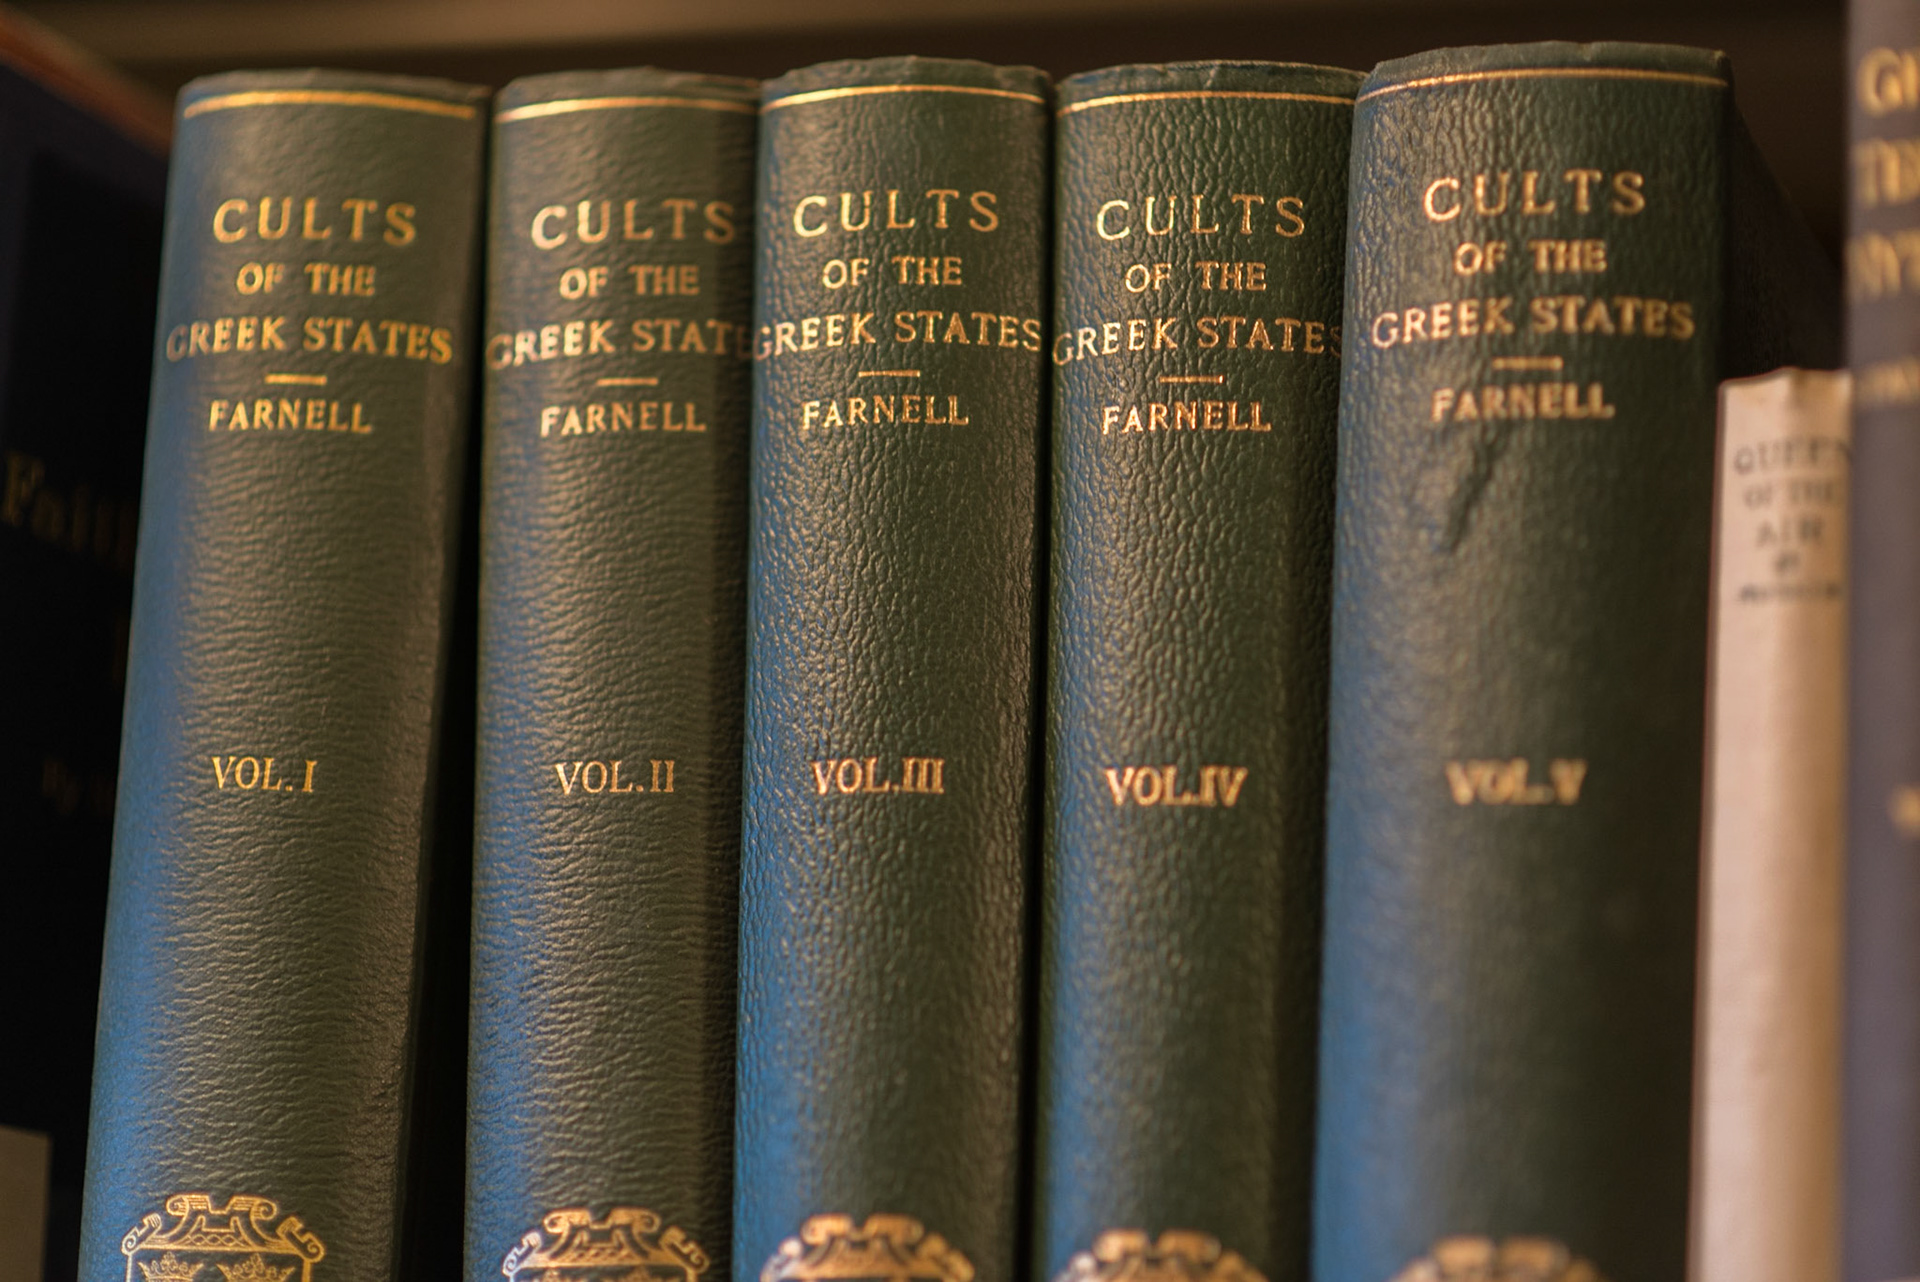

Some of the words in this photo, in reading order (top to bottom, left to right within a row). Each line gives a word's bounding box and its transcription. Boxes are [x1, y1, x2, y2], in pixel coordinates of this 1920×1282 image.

[793, 189, 1000, 238] CULTS
[1423, 168, 1646, 222] CULTS
[212, 197, 418, 246] CULTS
[531, 199, 736, 250] CULTS
[1095, 194, 1306, 241] CULTS
[235, 262, 284, 296] OF
[304, 263, 376, 297] THE
[822, 257, 870, 290] OF
[893, 256, 963, 286] THE
[1124, 263, 1172, 293] OF
[1196, 261, 1267, 291] THE
[1454, 241, 1507, 276] OF
[1529, 239, 1607, 273] THE
[559, 266, 608, 300] OF
[629, 265, 700, 297] THE
[165, 317, 287, 362] GREEK
[303, 317, 453, 364] STATES
[752, 312, 876, 362] GREEK
[894, 310, 1043, 352] STATES
[1052, 317, 1178, 366] GREEK
[1371, 296, 1515, 350] GREEK
[1530, 295, 1695, 340] STATES
[486, 320, 616, 370] GREEK
[208, 399, 373, 434] FARNELL
[539, 401, 707, 438] FARNELL
[801, 395, 970, 431] FARNELL
[1101, 401, 1273, 435] FARNELL
[1431, 382, 1616, 424] FARNELL
